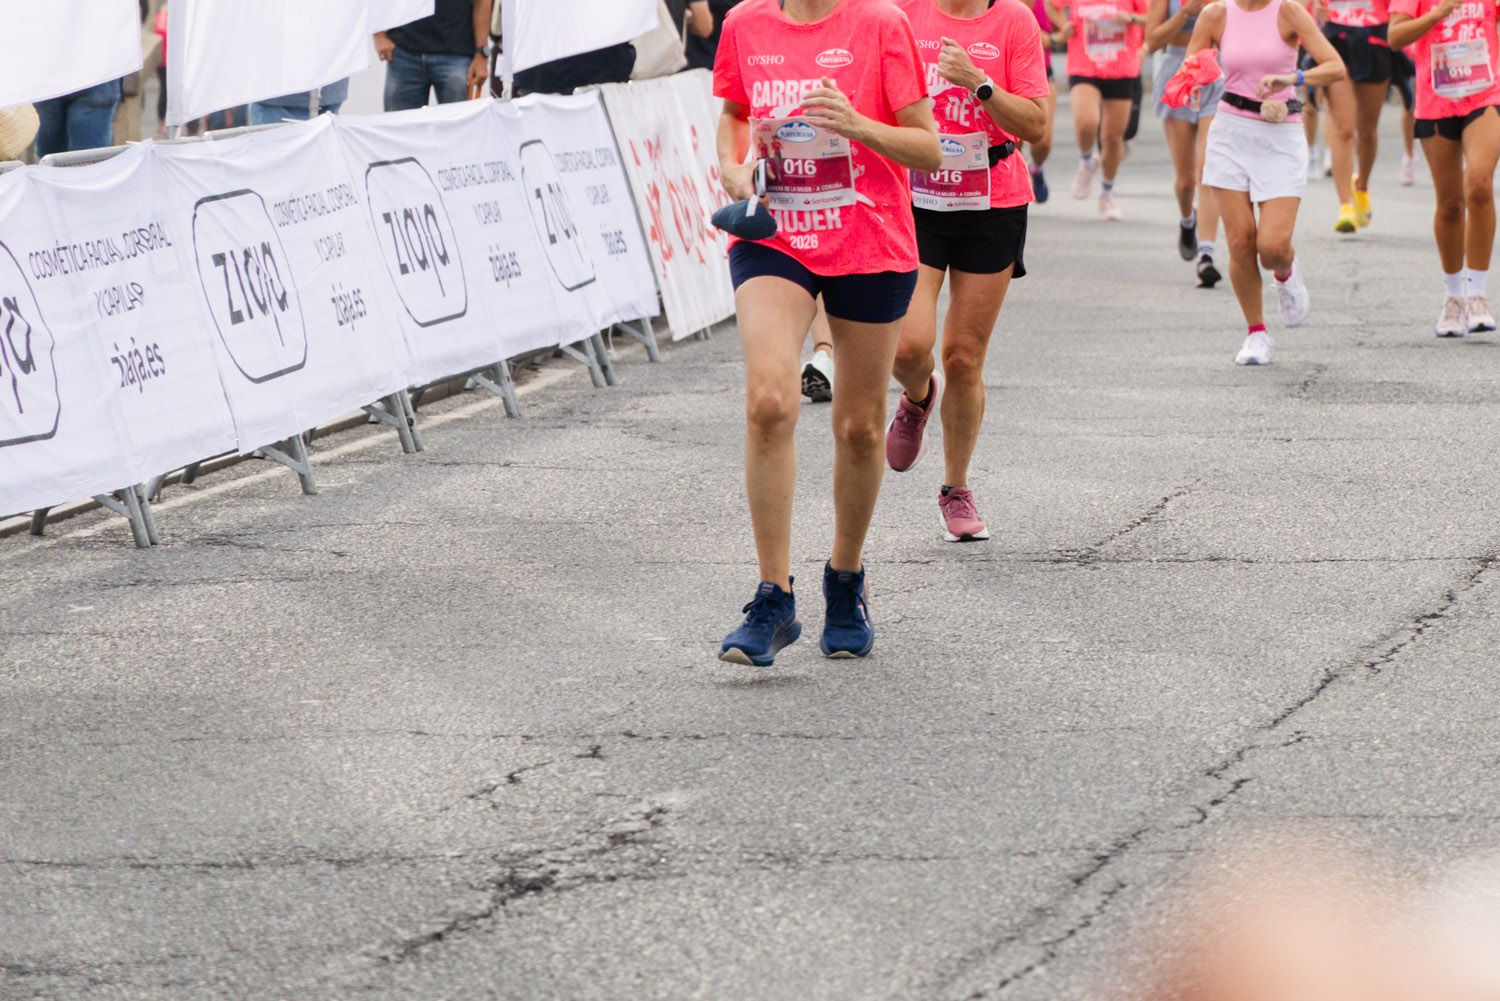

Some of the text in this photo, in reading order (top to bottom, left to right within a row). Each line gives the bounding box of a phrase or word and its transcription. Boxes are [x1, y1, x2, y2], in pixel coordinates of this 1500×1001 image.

[747, 55, 785, 66] OYSHO
[783, 158, 817, 175] 016
[790, 234, 819, 250] 2026
